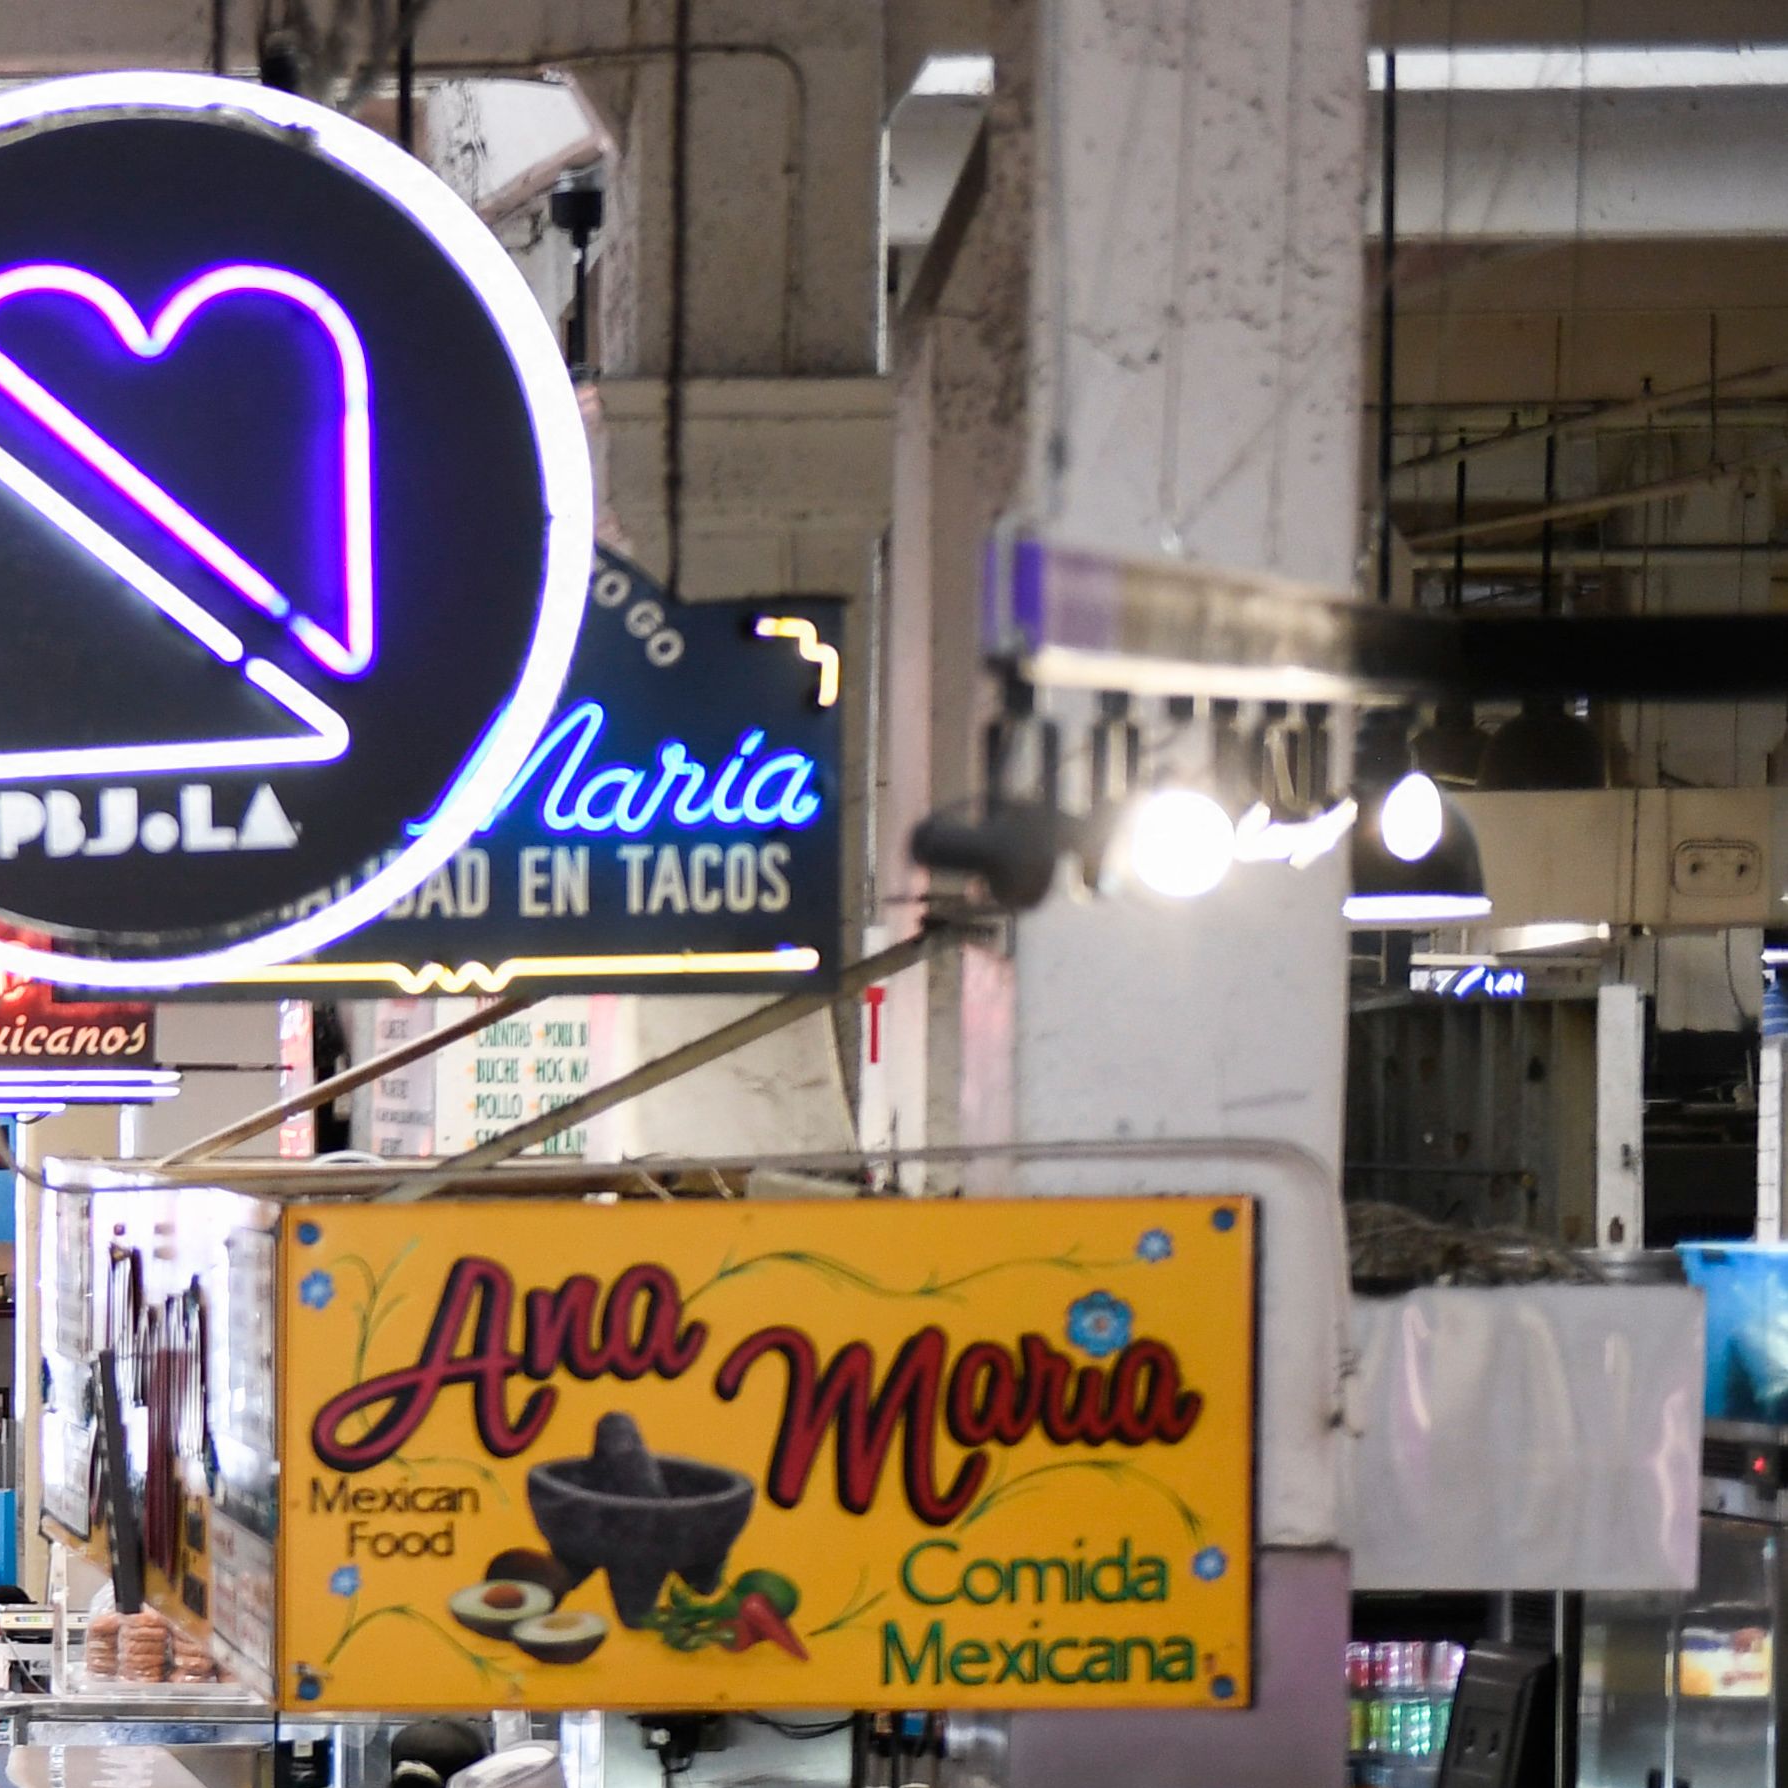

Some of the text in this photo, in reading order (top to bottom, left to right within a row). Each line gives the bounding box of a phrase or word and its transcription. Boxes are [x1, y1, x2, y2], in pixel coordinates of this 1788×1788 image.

[519, 845, 590, 917] EN
[617, 843, 792, 915] TACOS
[311, 1255, 707, 1474] Ana
[715, 1324, 1203, 1527] Maria
[309, 1475, 481, 1516] Mexican
[346, 1520, 457, 1559] Food
[901, 1540, 1169, 1605] Comida
[880, 1619, 1196, 1687] Mexicana
